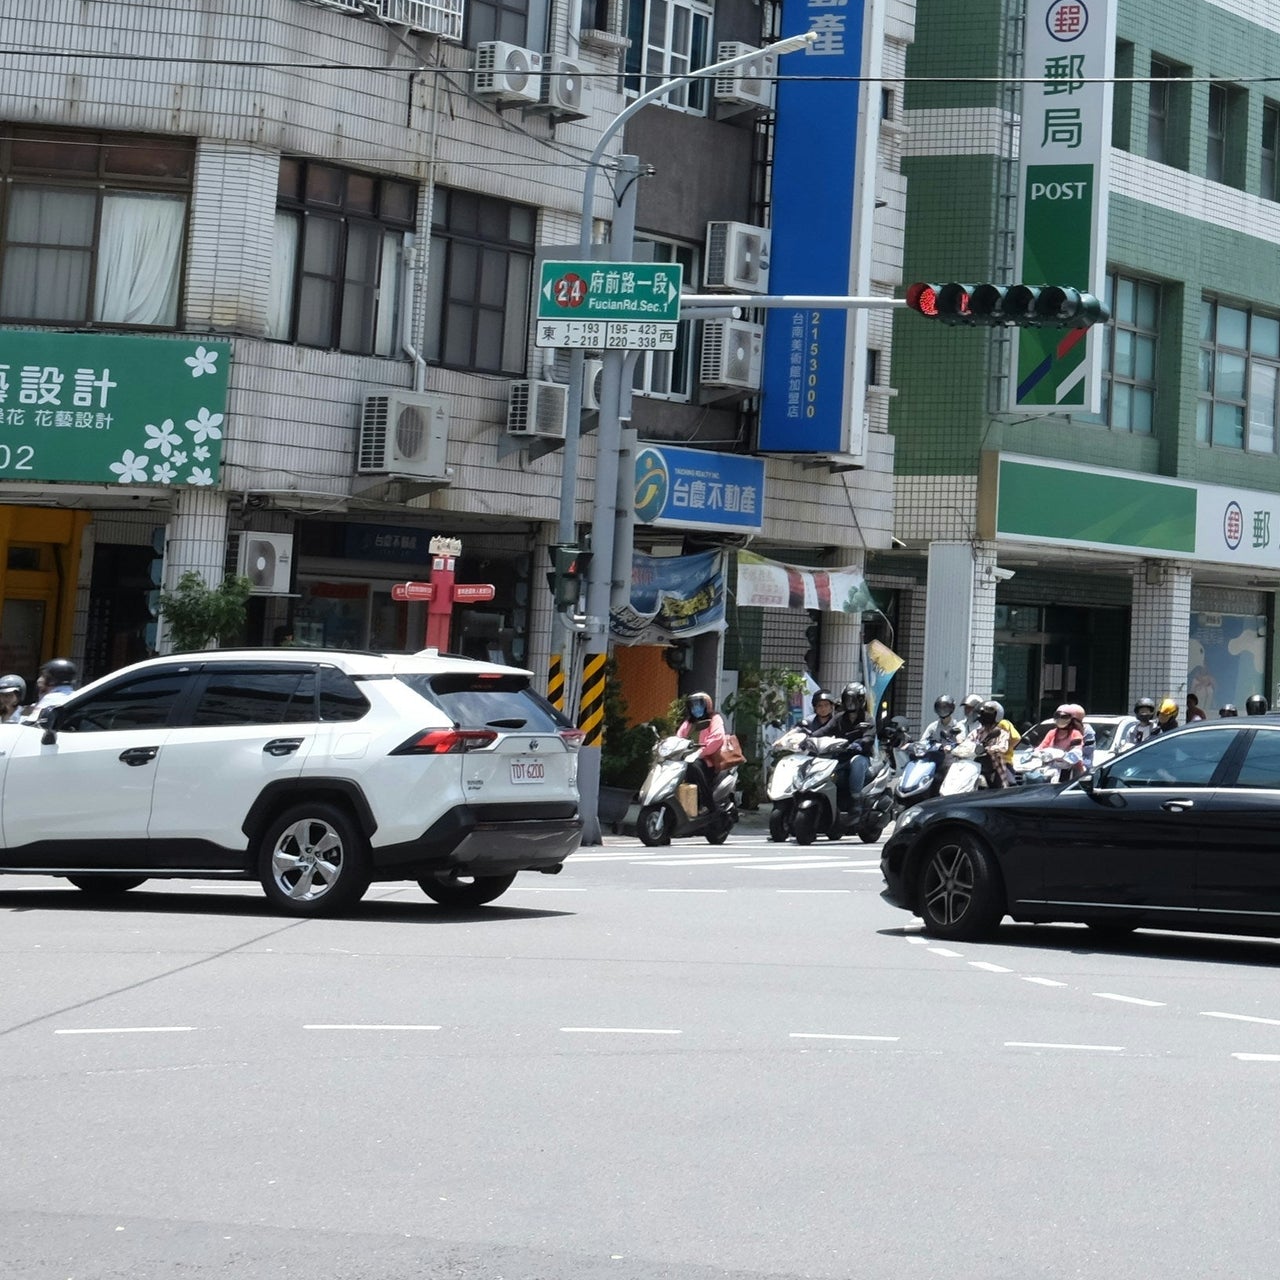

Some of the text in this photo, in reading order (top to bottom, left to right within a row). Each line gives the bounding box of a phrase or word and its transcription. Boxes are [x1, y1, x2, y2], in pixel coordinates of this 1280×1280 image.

[1040, 55, 1086, 149] 郵局
[1031, 181, 1087, 201] POST
[558, 281, 581, 301] 24
[589, 271, 668, 294] 府前路一段
[542, 326, 557, 341] 東
[659, 328, 675, 343] 西
[806, 312, 820, 418] 2153000
[34, 410, 114, 430] 花藝設計
[673, 478, 756, 514] 台慶不動產
